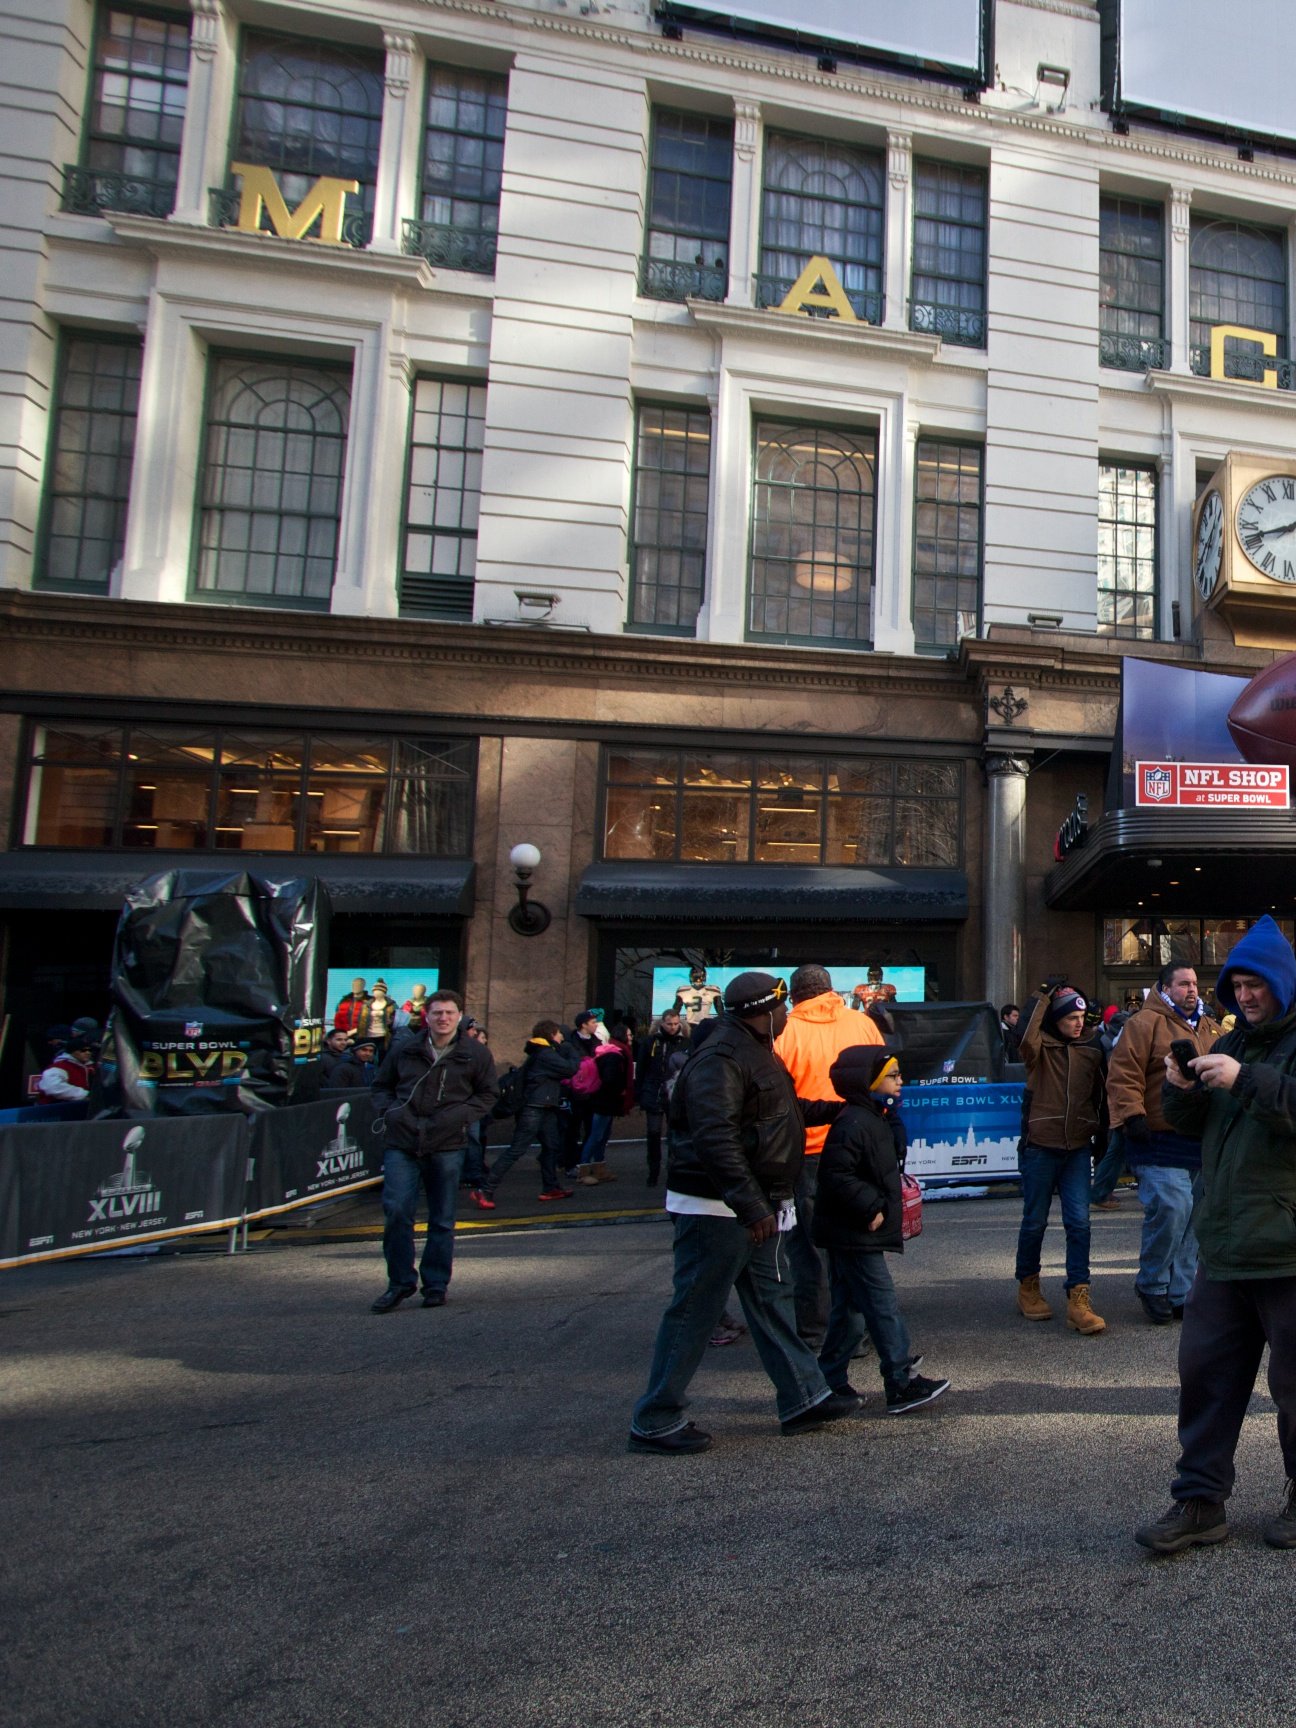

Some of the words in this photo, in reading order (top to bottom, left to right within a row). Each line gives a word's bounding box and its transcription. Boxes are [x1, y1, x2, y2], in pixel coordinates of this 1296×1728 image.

[1184, 769, 1225, 785] NFL
[1229, 771, 1282, 787] SHOP
[1148, 780, 1169, 795] NFL
[1196, 794, 1205, 802] at
[1208, 794, 1240, 803] SUPER
[1243, 795, 1271, 804] BOWL
[152, 1041, 195, 1050] SUPER
[199, 1041, 237, 1050] BOWL
[139, 1050, 249, 1079] BLVD
[919, 1076, 949, 1086] SUPER
[951, 1076, 978, 1084] BOWL
[902, 1097, 950, 1108] SUPER
[956, 1097, 995, 1107] BOWL
[315, 1150, 364, 1178] XLVIII
[951, 1154, 988, 1166] ESPN
[87, 1191, 161, 1222] XLVIII
[72, 1230, 92, 1239] NEW
[95, 1224, 116, 1235] YORK
[120, 1221, 137, 1231] NEW
[138, 1216, 168, 1228] JERSEY
[28, 1235, 55, 1247] ESPN
